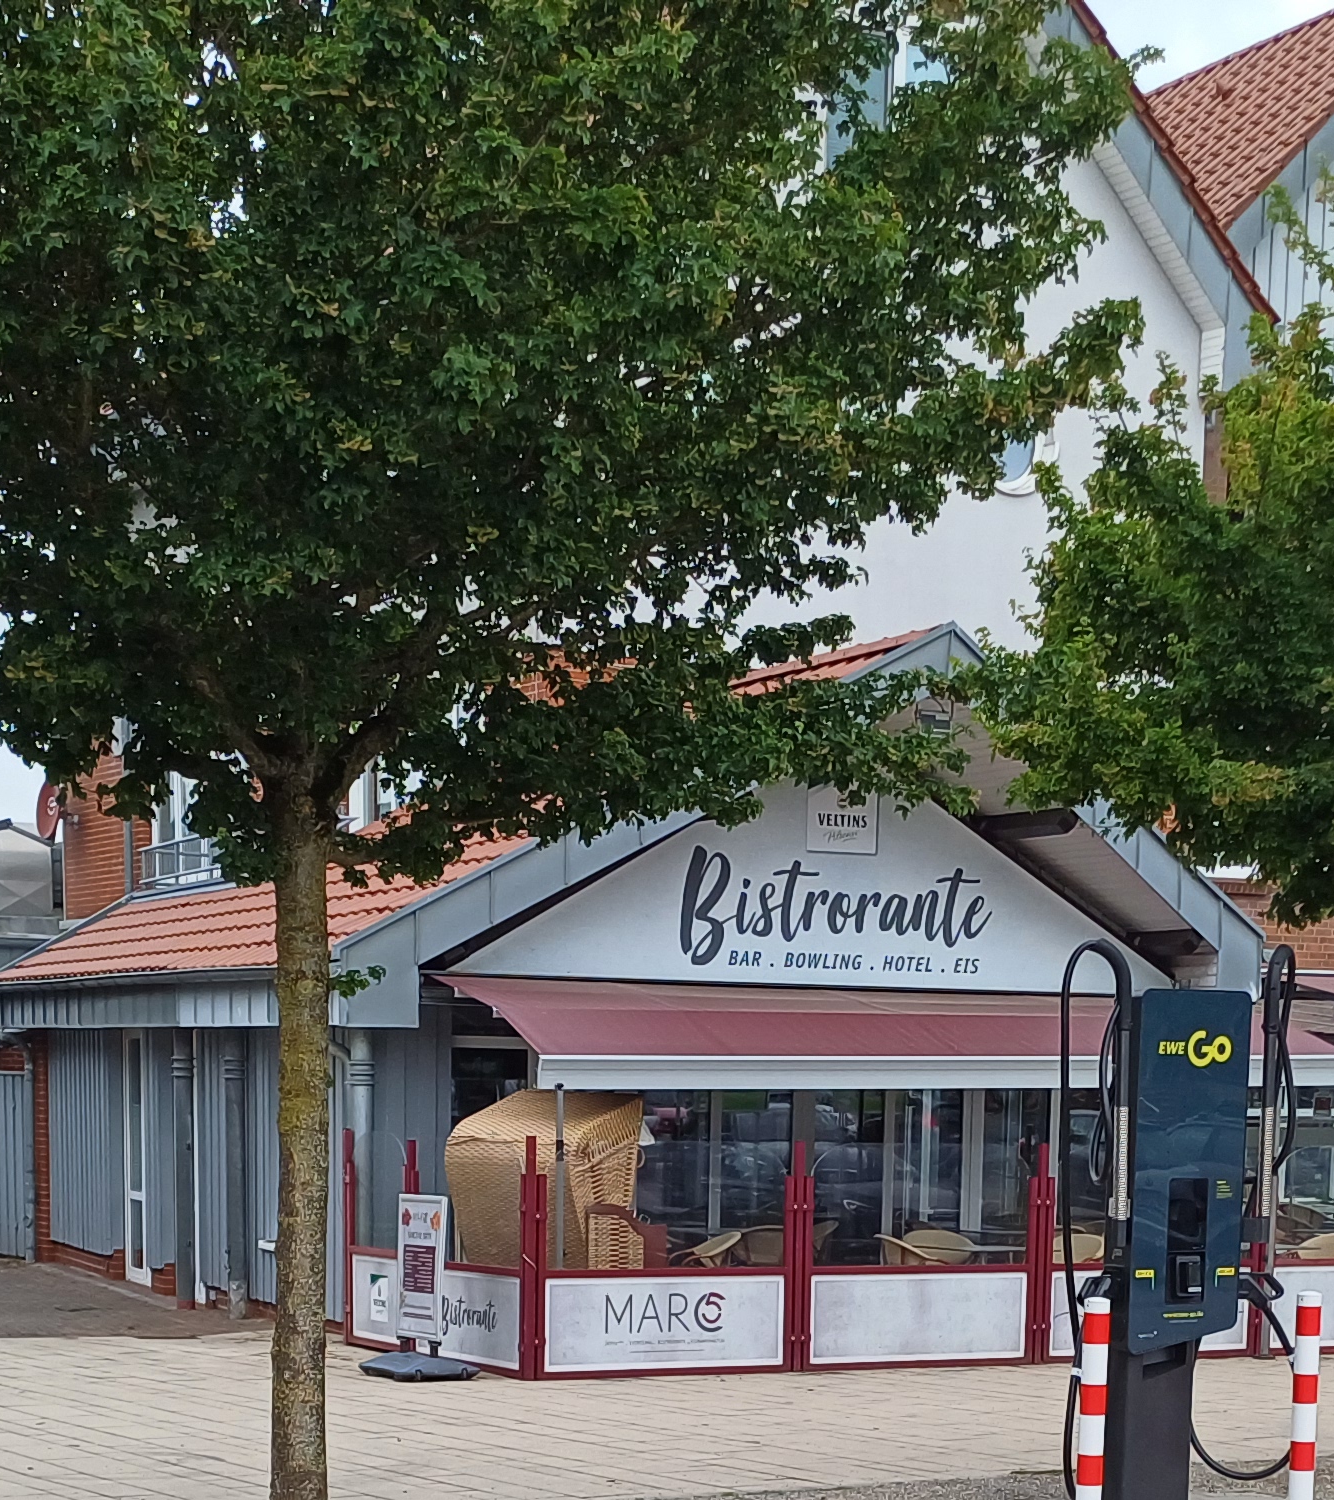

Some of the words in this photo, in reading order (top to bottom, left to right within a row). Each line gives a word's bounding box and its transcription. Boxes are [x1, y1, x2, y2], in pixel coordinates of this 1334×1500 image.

[817, 812, 868, 829] VELTINS
[679, 844, 993, 966] Bistrorante
[727, 950, 762, 968] BAR
[783, 951, 863, 971] BOWLING
[881, 955, 934, 974] HOTEL
[952, 958, 980, 975] EIS
[1158, 1041, 1186, 1055] EWE
